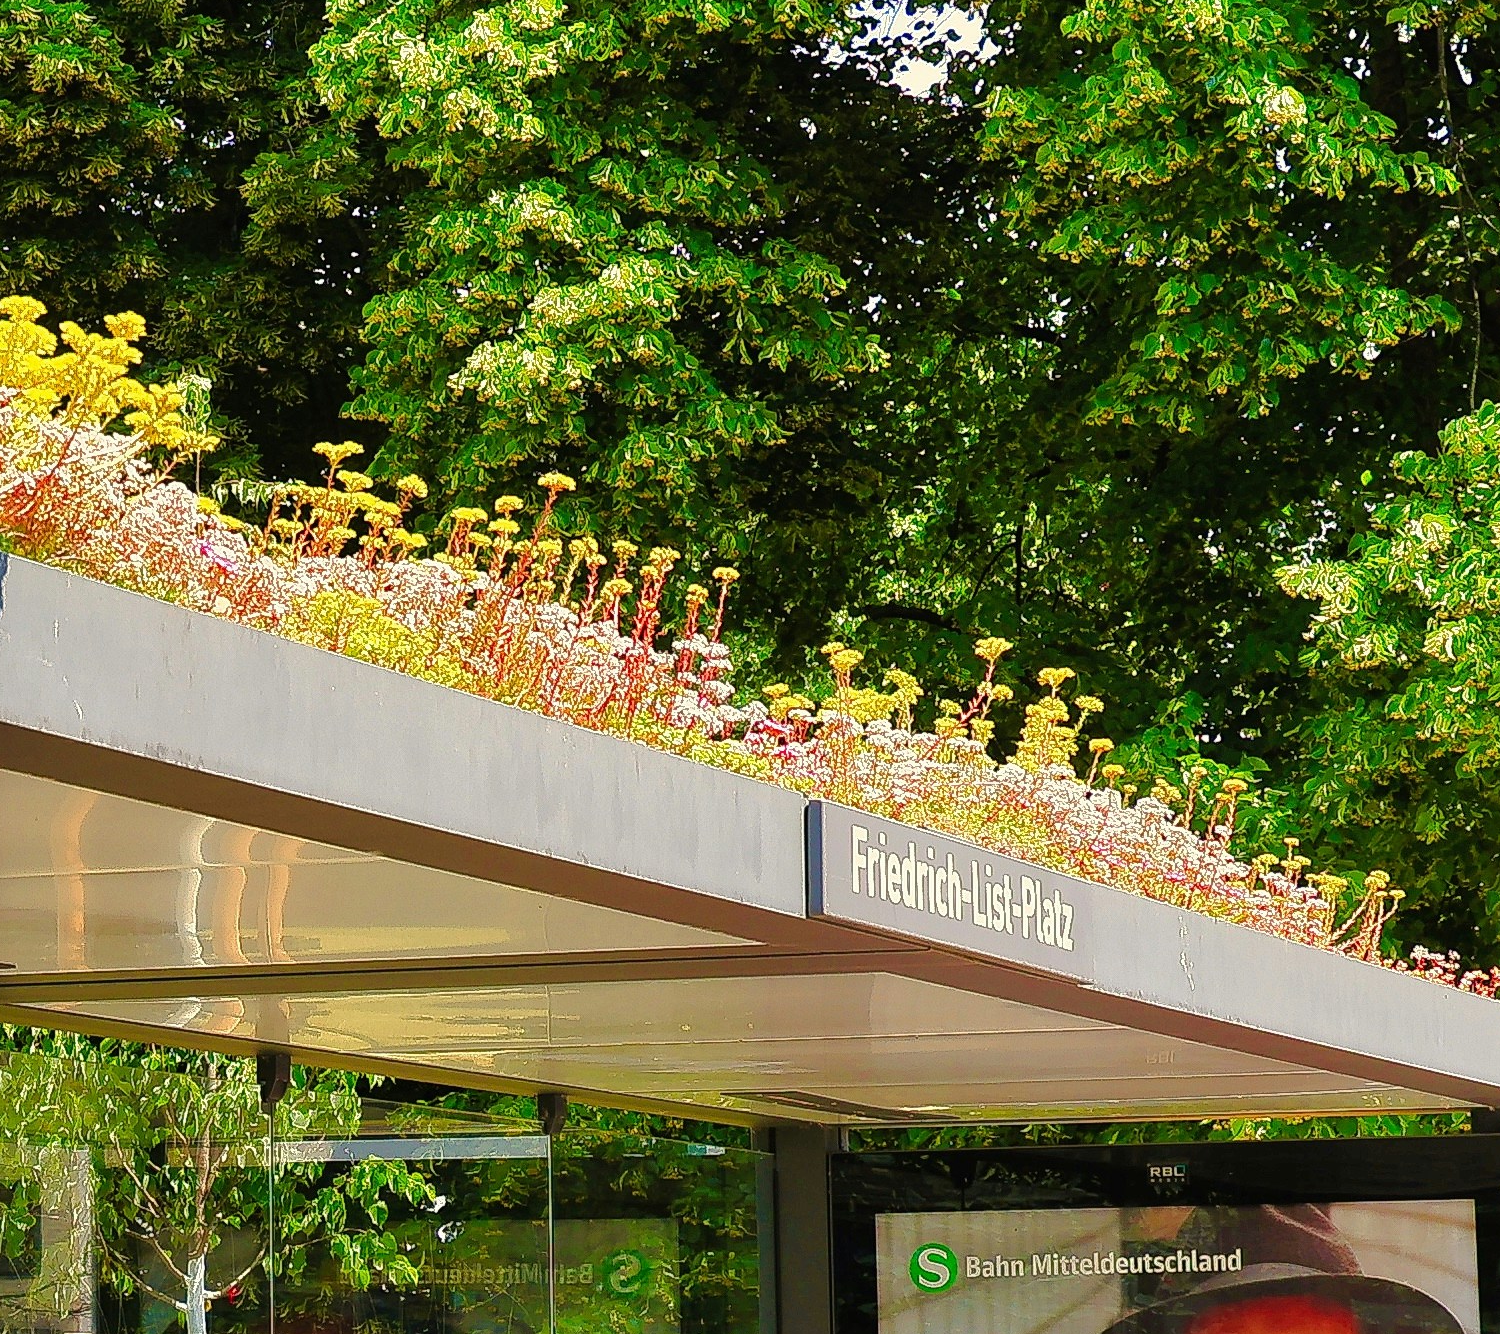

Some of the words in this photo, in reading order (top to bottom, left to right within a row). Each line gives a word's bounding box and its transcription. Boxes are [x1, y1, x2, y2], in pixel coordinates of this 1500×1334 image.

[851, 824, 1075, 952] Friedrich-List-Platz
[1149, 1166, 1186, 1178] RBL
[917, 1247, 952, 1288] S
[965, 1255, 1025, 1279] Bahn
[1031, 1247, 1243, 1277] Mitteldeutschland
